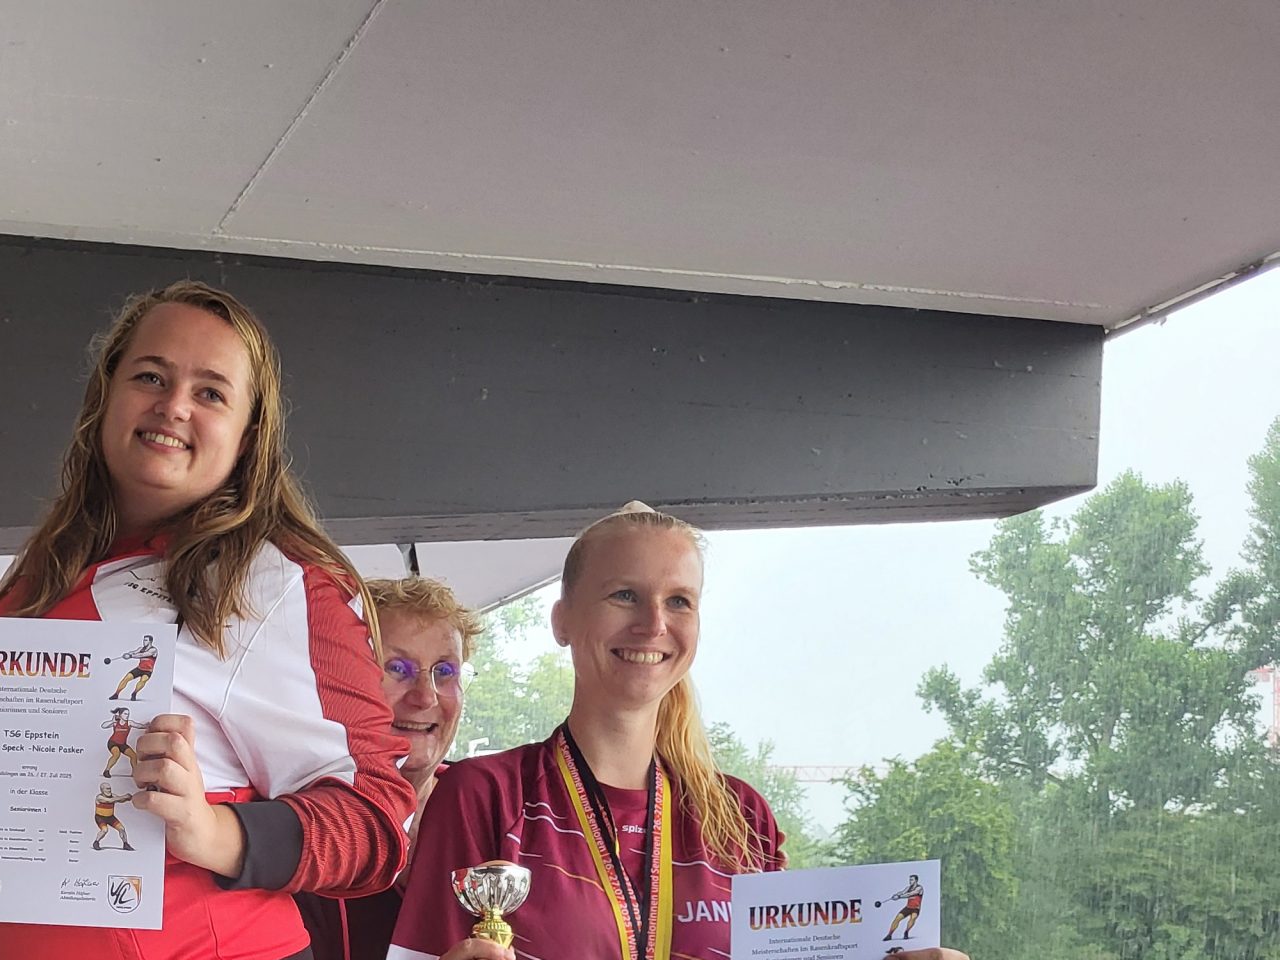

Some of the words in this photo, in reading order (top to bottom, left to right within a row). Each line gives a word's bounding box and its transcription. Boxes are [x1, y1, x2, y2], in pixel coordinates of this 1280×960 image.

[24, 730, 59, 740] Eppstein
[2, 744, 24, 752] Speck
[562, 746, 585, 792] Seniorinnen
[580, 794, 593, 812] und
[587, 812, 607, 852] Senioren
[651, 834, 660, 874] Senioren
[650, 875, 659, 893] und
[749, 899, 862, 930] URKUNDE
[646, 894, 658, 954] Seniorinnen
[769, 936, 811, 944] Internationale
[752, 947, 799, 955] Meisterschaften
